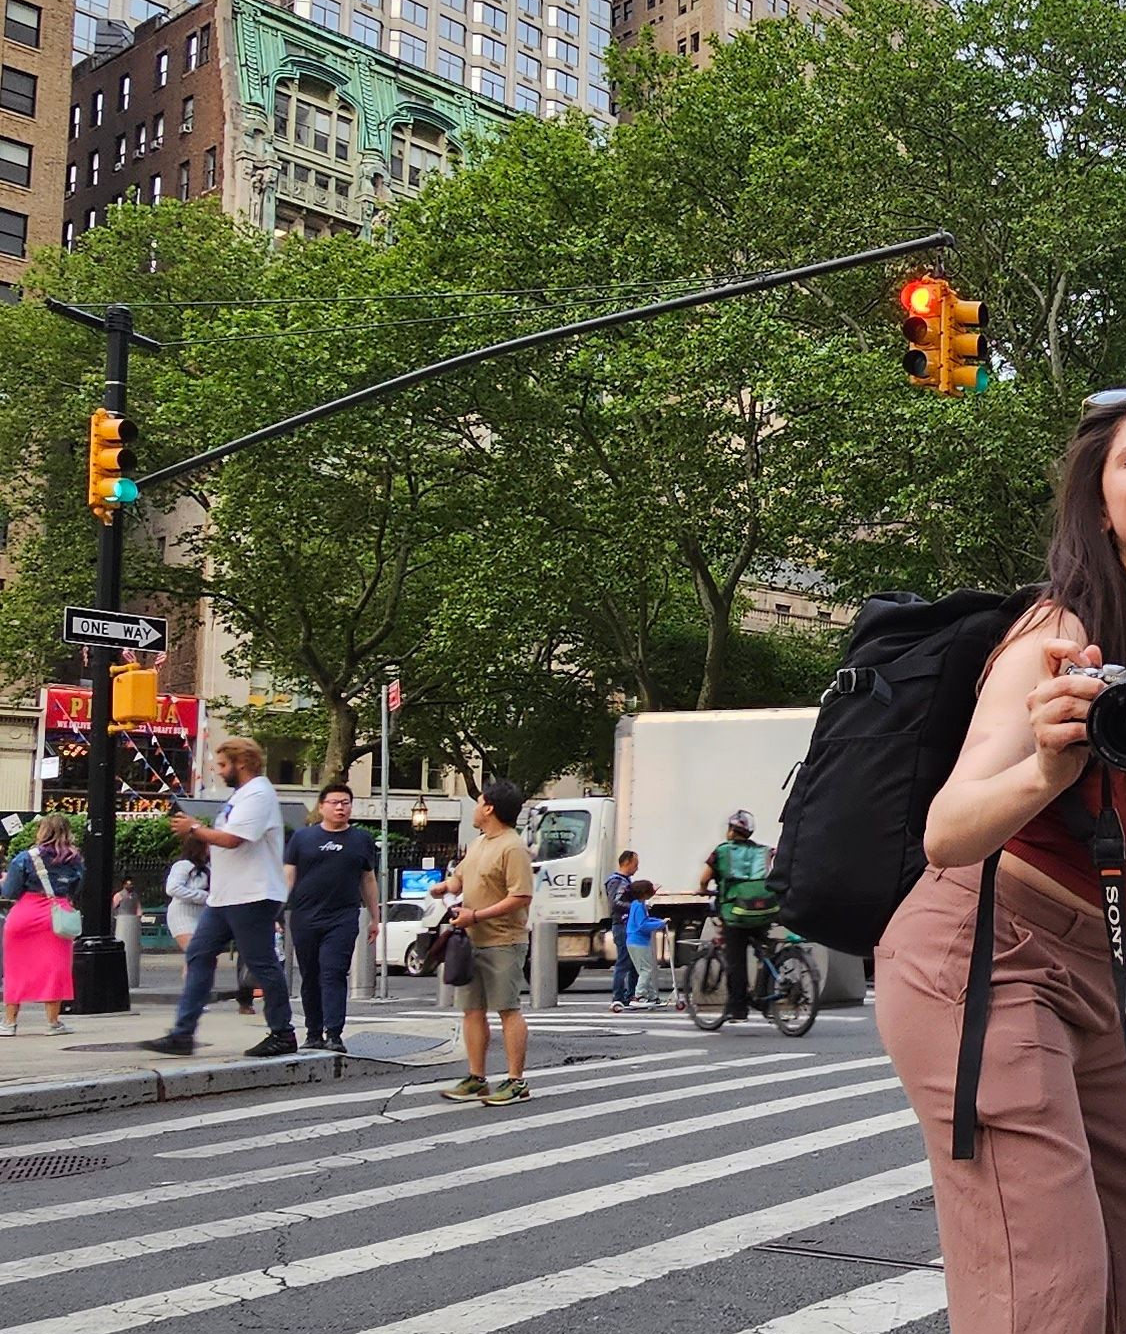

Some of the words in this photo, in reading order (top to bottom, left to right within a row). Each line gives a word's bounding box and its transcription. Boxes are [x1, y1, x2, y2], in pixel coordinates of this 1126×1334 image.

[81, 621, 109, 635] ONE
[123, 625, 152, 640] WAY
[536, 869, 577, 890] ACE
[1106, 886, 1124, 965] SONY
